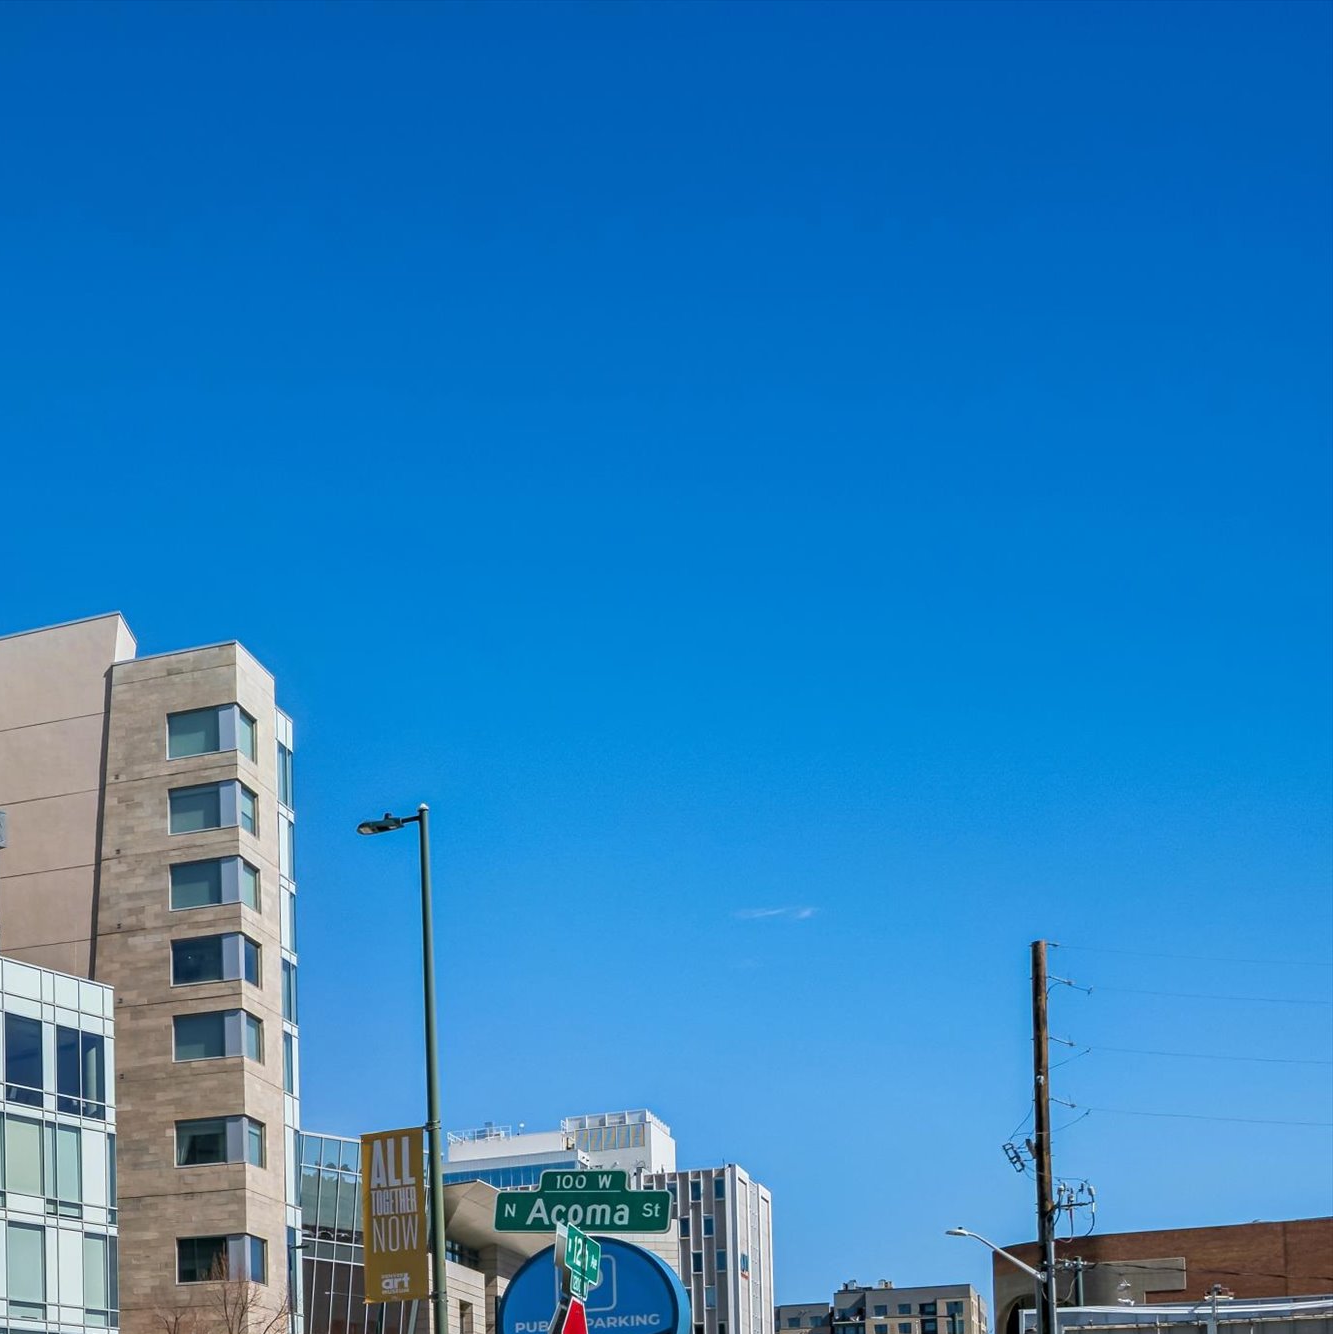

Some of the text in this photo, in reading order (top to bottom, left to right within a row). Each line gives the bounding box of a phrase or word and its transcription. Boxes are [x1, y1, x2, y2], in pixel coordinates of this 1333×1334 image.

[370, 1136, 416, 1188] ALL
[556, 1174, 613, 1189] 100 W
[371, 1186, 417, 1216] TOGETHER
[504, 1198, 661, 1225] N Acoma St
[372, 1214, 419, 1253] NOW
[381, 1273, 410, 1290] art
[515, 1313, 660, 1334] PUB PARKING
